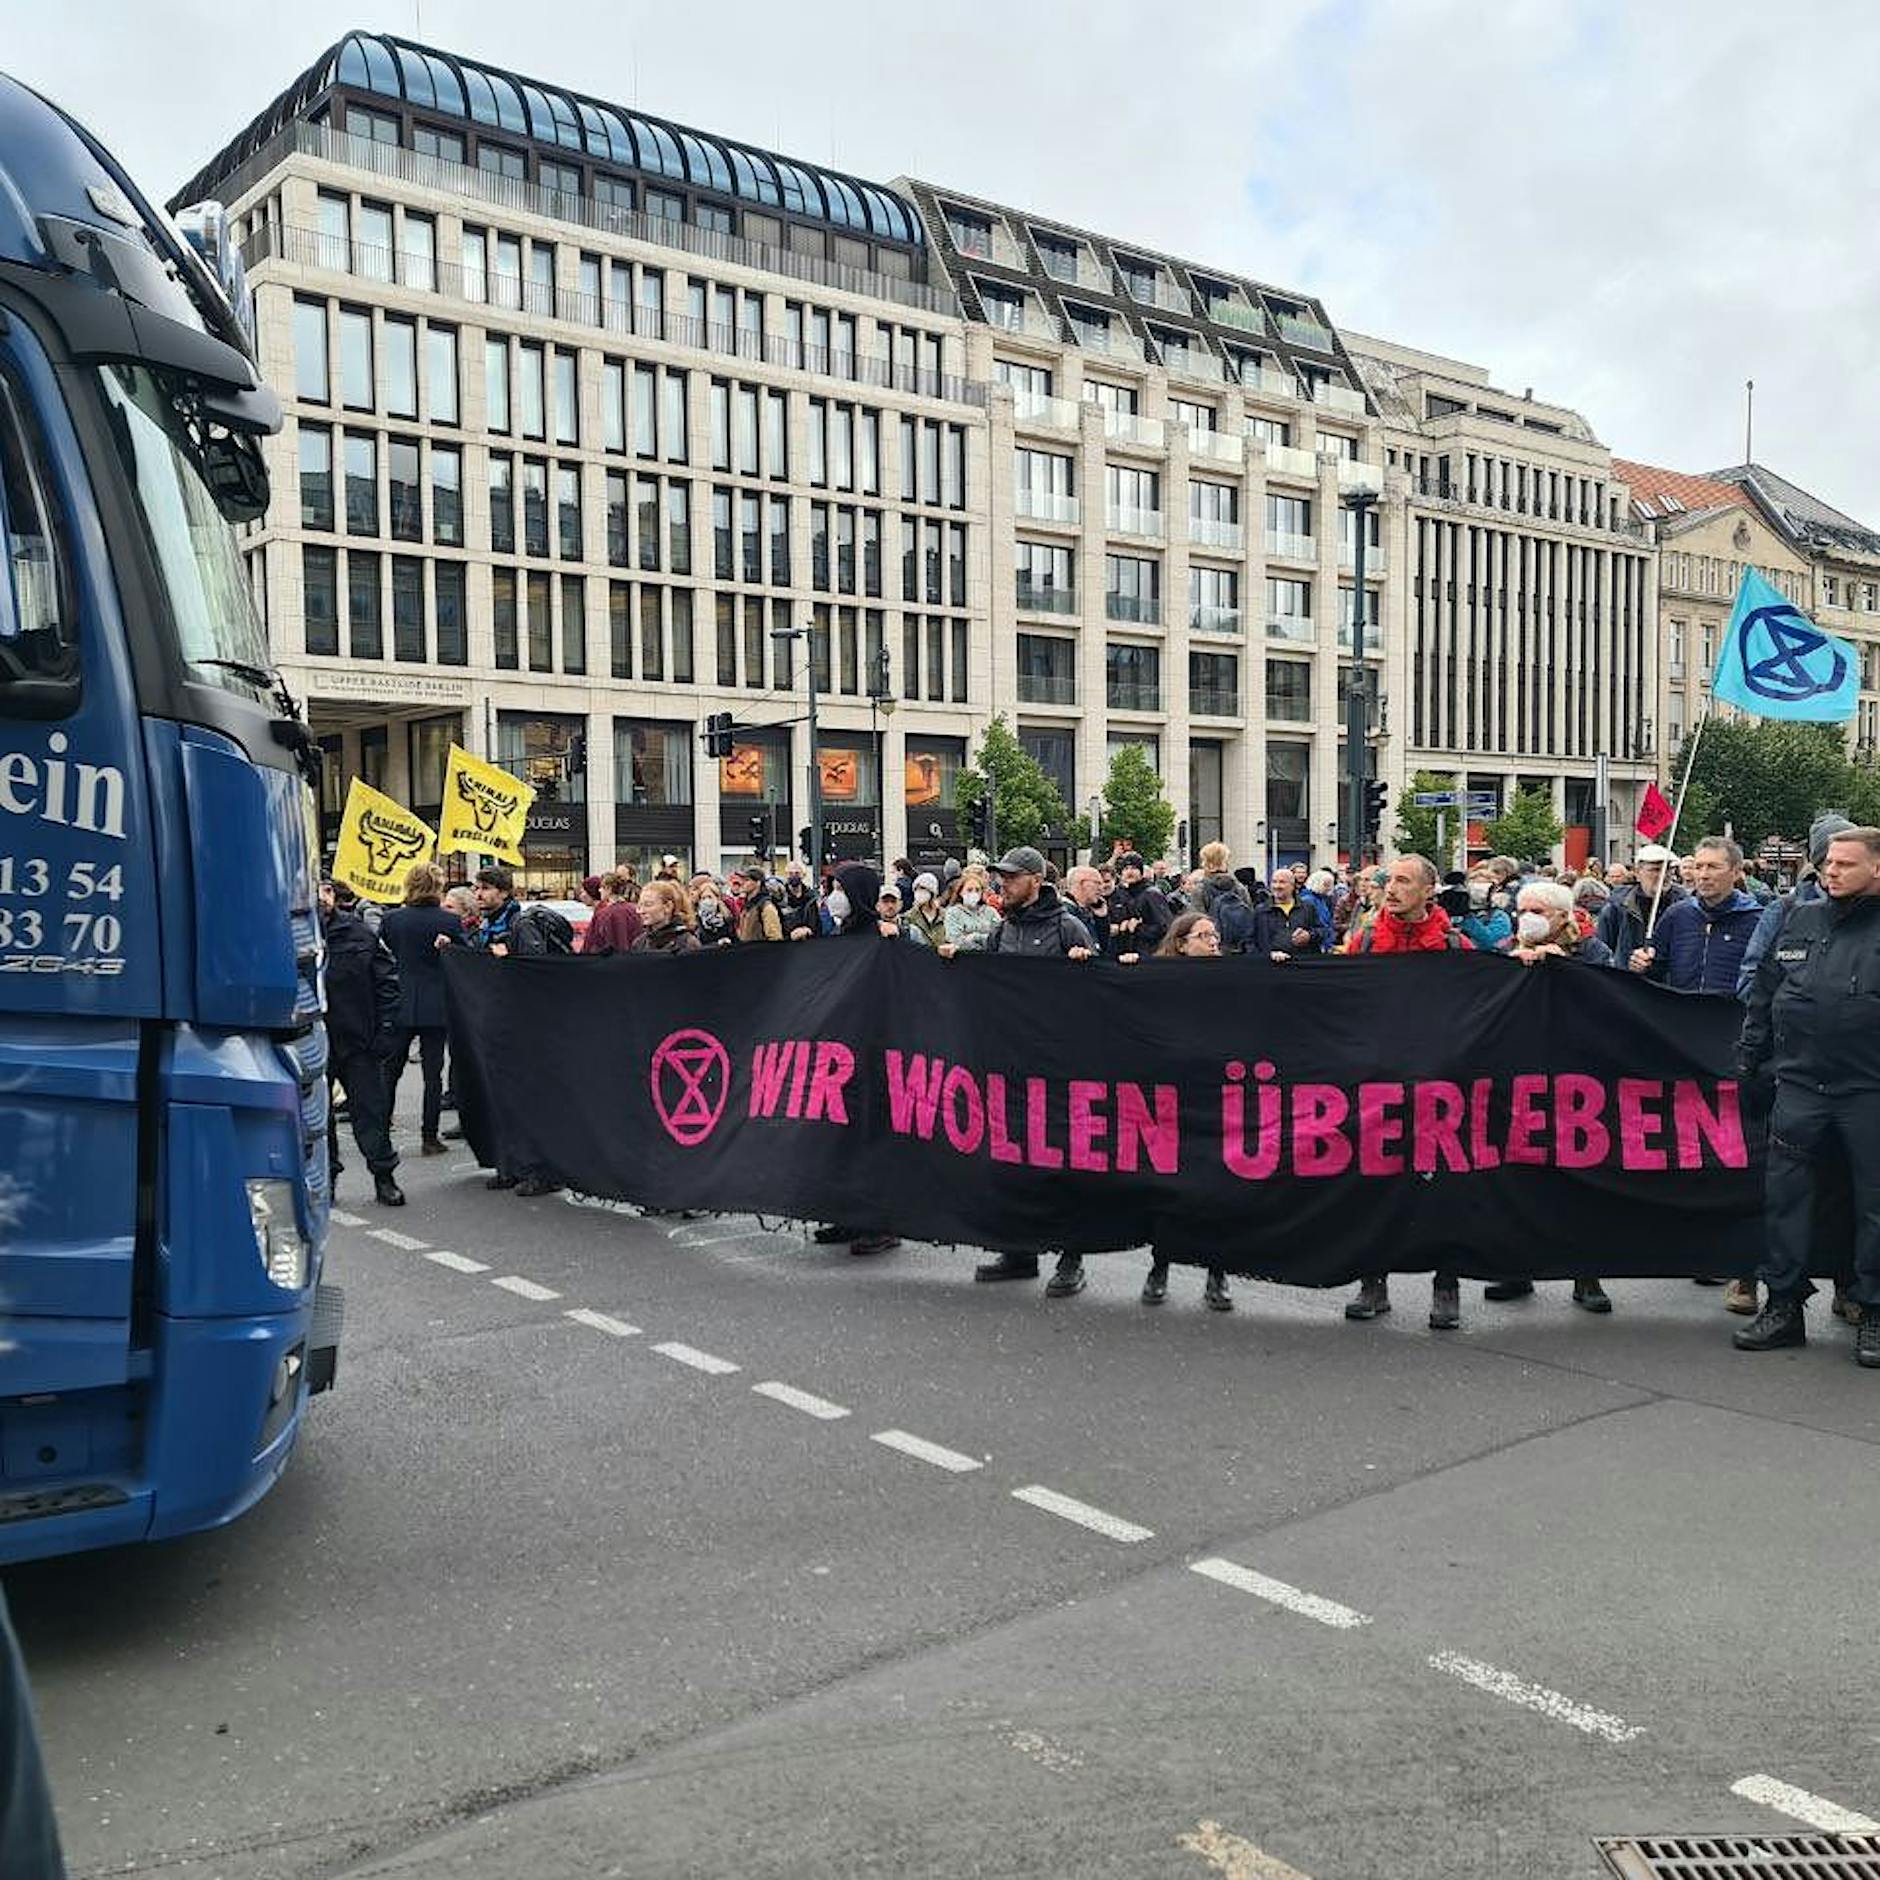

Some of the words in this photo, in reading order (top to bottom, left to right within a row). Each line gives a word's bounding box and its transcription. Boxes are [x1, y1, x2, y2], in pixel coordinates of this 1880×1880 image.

[0, 731, 126, 840] ein
[526, 817, 571, 829] OUGLAS
[0, 856, 50, 896] 13
[67, 862, 124, 901] 54
[63, 913, 121, 954] 70
[749, 1040, 855, 1124] WIR
[886, 1049, 1179, 1174] WOLLEN
[1222, 1060, 1748, 1180] ÜBERLEBEN
